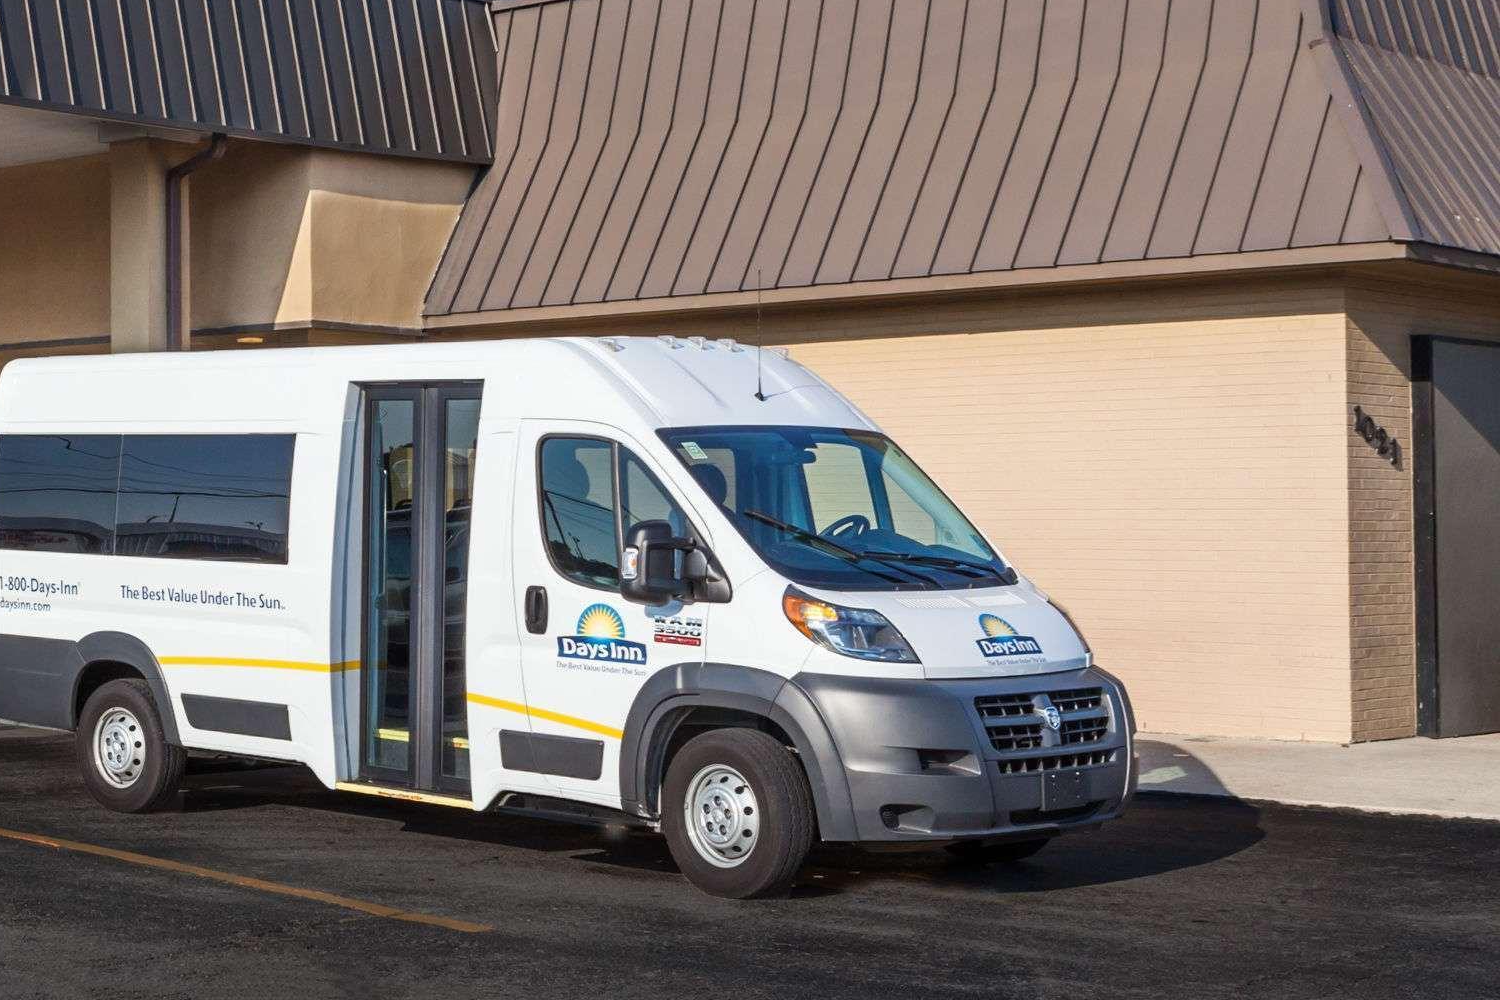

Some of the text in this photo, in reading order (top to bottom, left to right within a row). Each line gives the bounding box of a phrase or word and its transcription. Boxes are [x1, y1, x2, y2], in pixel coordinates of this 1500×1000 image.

[0, 576, 79, 598] 1-800-Days-Inn
[120, 585, 140, 600] The
[142, 586, 165, 601] Best
[167, 587, 198, 603] Value
[200, 590, 234, 606] Under
[236, 592, 257, 608] The
[0, 597, 51, 612] daysinn.com
[654, 616, 702, 627] RAM
[562, 638, 643, 661] Days Inn
[980, 638, 1040, 654] Days Inn
